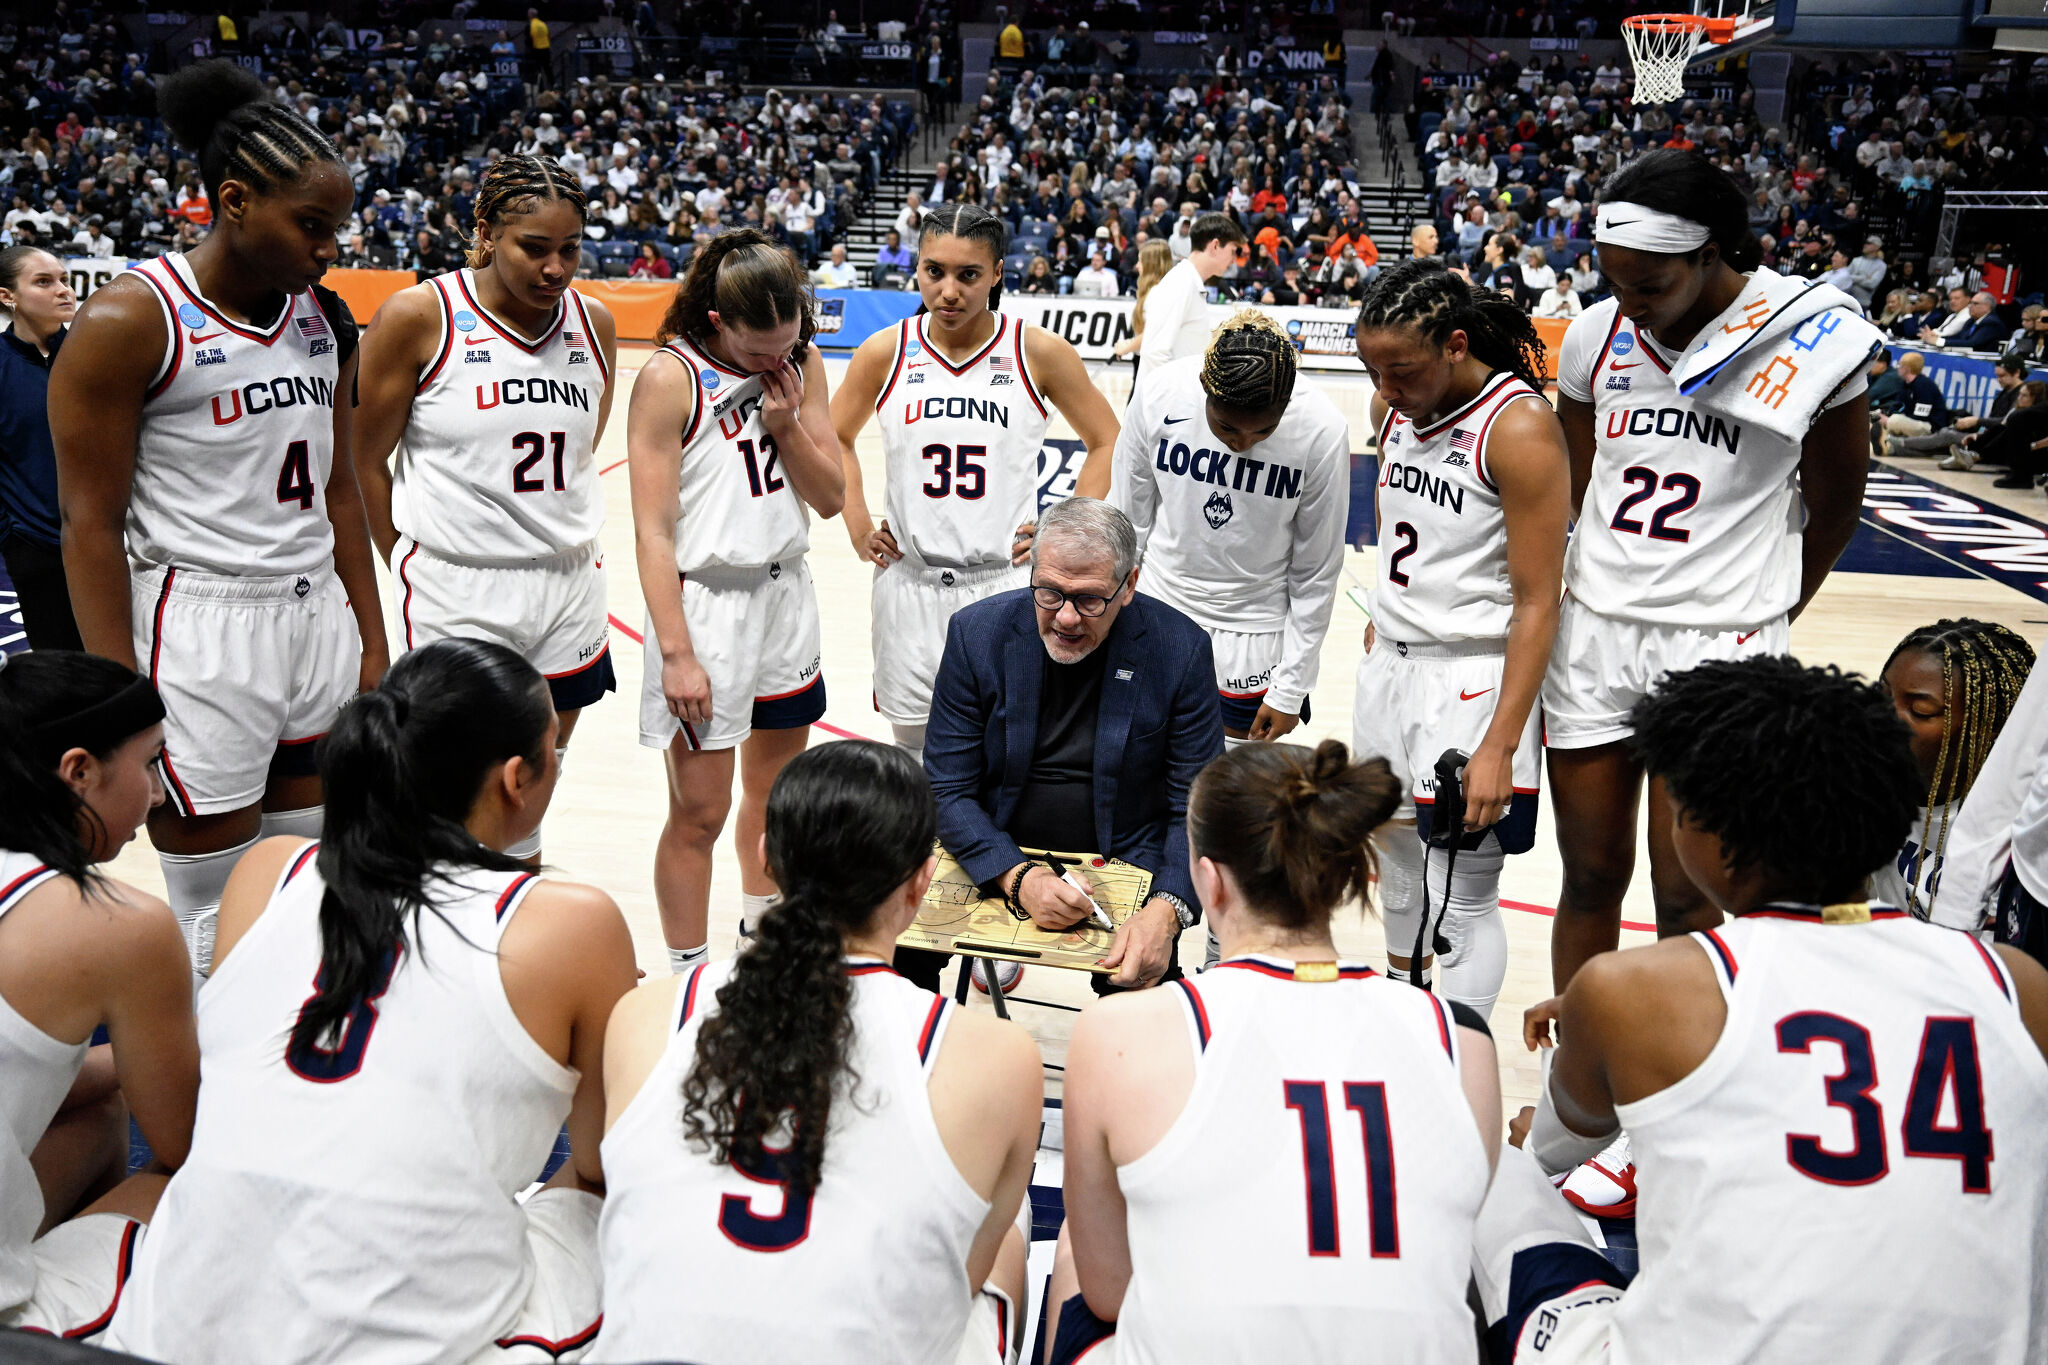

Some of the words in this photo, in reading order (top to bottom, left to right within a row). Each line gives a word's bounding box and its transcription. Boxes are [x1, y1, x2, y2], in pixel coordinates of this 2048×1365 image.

[599, 37, 625, 48] 109
[882, 44, 912, 56] 109
[1247, 50, 1326, 70] DNKIN
[1847, 83, 1873, 99] 12
[310, 338, 328, 347] BIG
[1041, 310, 1135, 346] UCON
[1300, 321, 1348, 337] MARCH
[1304, 336, 1358, 352] MADNES
[194, 354, 227, 367] CHANGE
[195, 349, 208, 359] BE
[208, 347, 223, 357] THE
[309, 343, 335, 356] EAST
[464, 356, 491, 364] CHANGE
[475, 377, 589, 413] UCONN
[1605, 382, 1631, 391] CHANGE
[1618, 376, 1632, 384] THE
[211, 376, 333, 426] UCONN
[905, 397, 1008, 429] UCONN
[1606, 407, 1741, 455] UCONN
[512, 431, 567, 492] 21
[736, 433, 786, 498] 12
[1156, 438, 1232, 487] LOCK
[1232, 457, 1265, 494] IT
[1445, 456, 1470, 468] EAST
[1450, 450, 1467, 459] BIG
[277, 439, 315, 510] 4
[921, 443, 988, 501] 35
[1379, 462, 1465, 515] UCONN
[1609, 466, 1702, 543] 22
[1389, 521, 1419, 588] 2
[285, 940, 403, 1084] 8
[1775, 1009, 1993, 1195] 34
[717, 1085, 825, 1253] 9
[1282, 1079, 1400, 1259] 11
